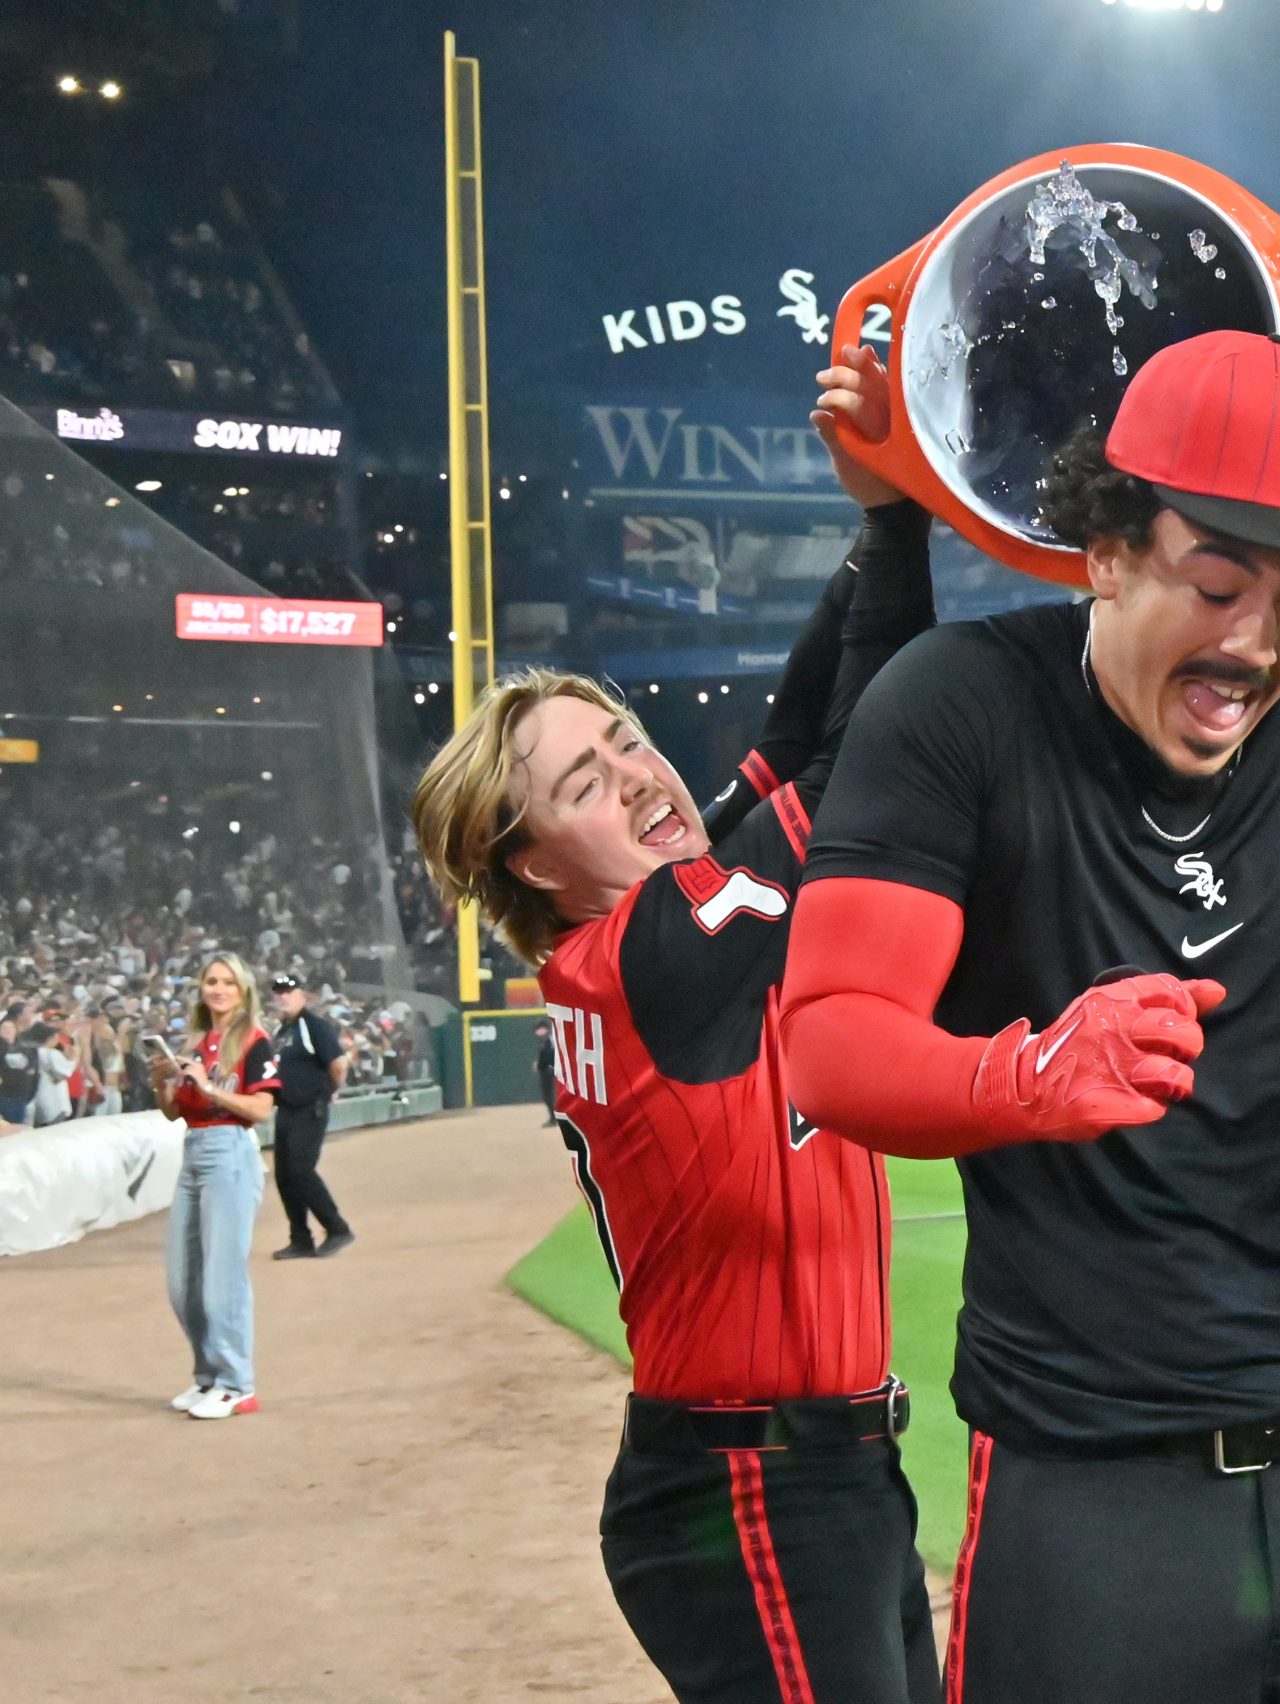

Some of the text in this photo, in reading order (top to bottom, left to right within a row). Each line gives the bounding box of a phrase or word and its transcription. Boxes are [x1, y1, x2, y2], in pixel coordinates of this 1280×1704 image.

[602, 295, 747, 353] KIDS
[194, 419, 341, 456] SOX WIN!
[586, 405, 841, 484] WINT
[260, 608, 356, 637] $17,527
[546, 1002, 608, 1106] TH
